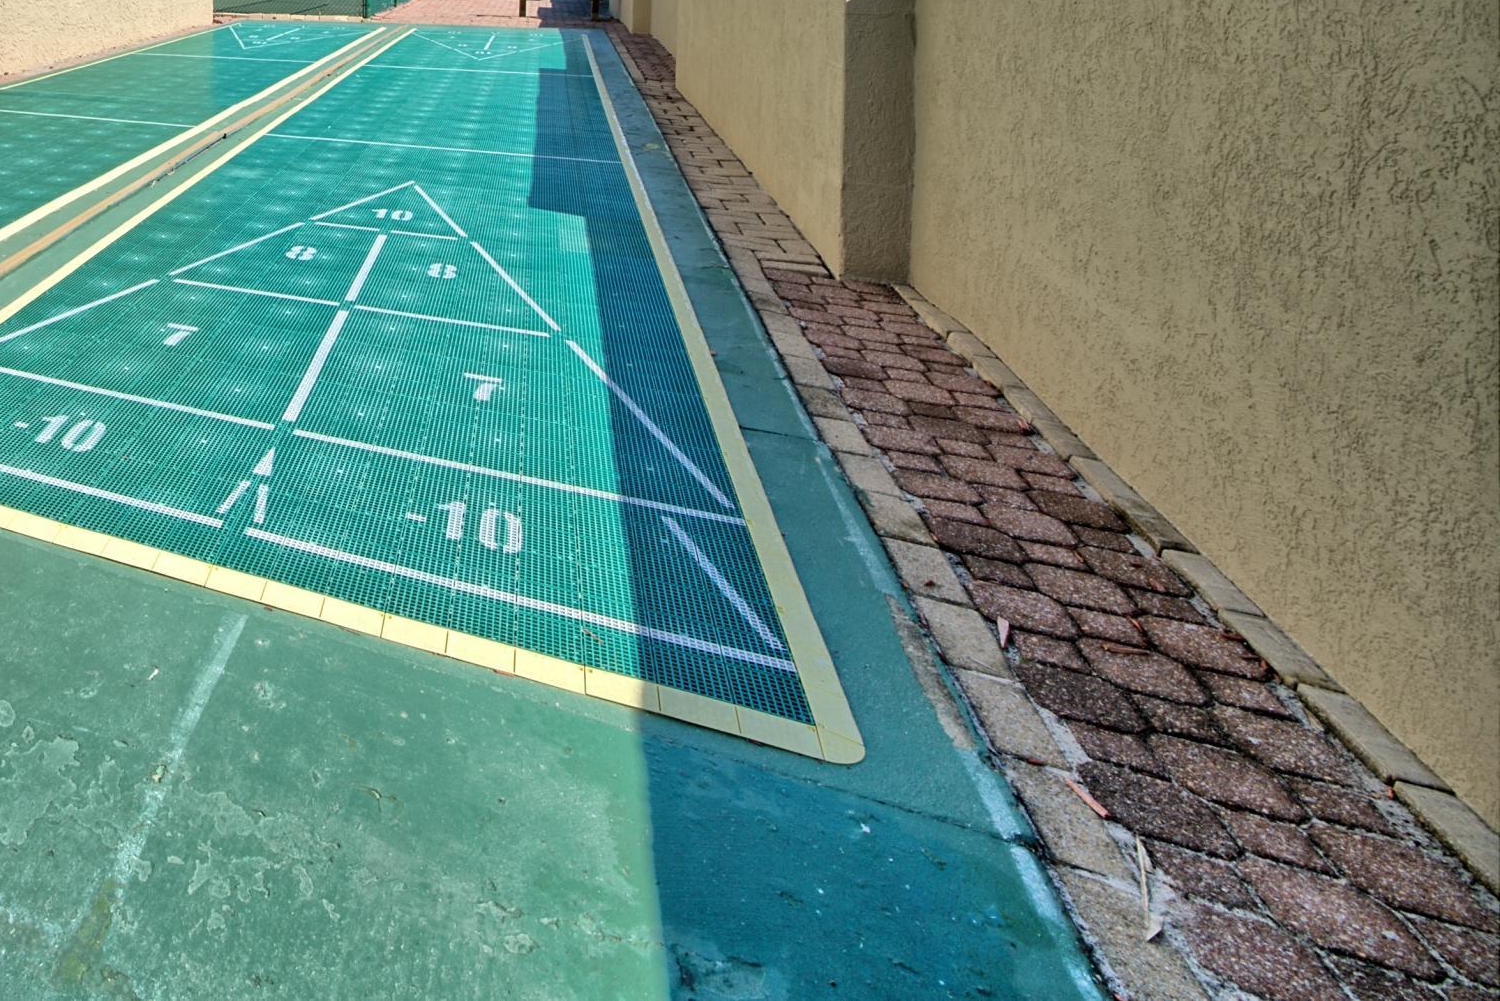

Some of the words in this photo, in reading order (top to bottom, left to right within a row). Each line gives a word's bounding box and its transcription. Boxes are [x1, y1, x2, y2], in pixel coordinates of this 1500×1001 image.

[371, 208, 413, 221] 10
[285, 245, 317, 261] 8
[426, 262, 458, 280] 8
[163, 322, 198, 347] 7
[463, 372, 503, 401] 7
[13, 414, 106, 452] -10
[406, 501, 521, 553] -10
